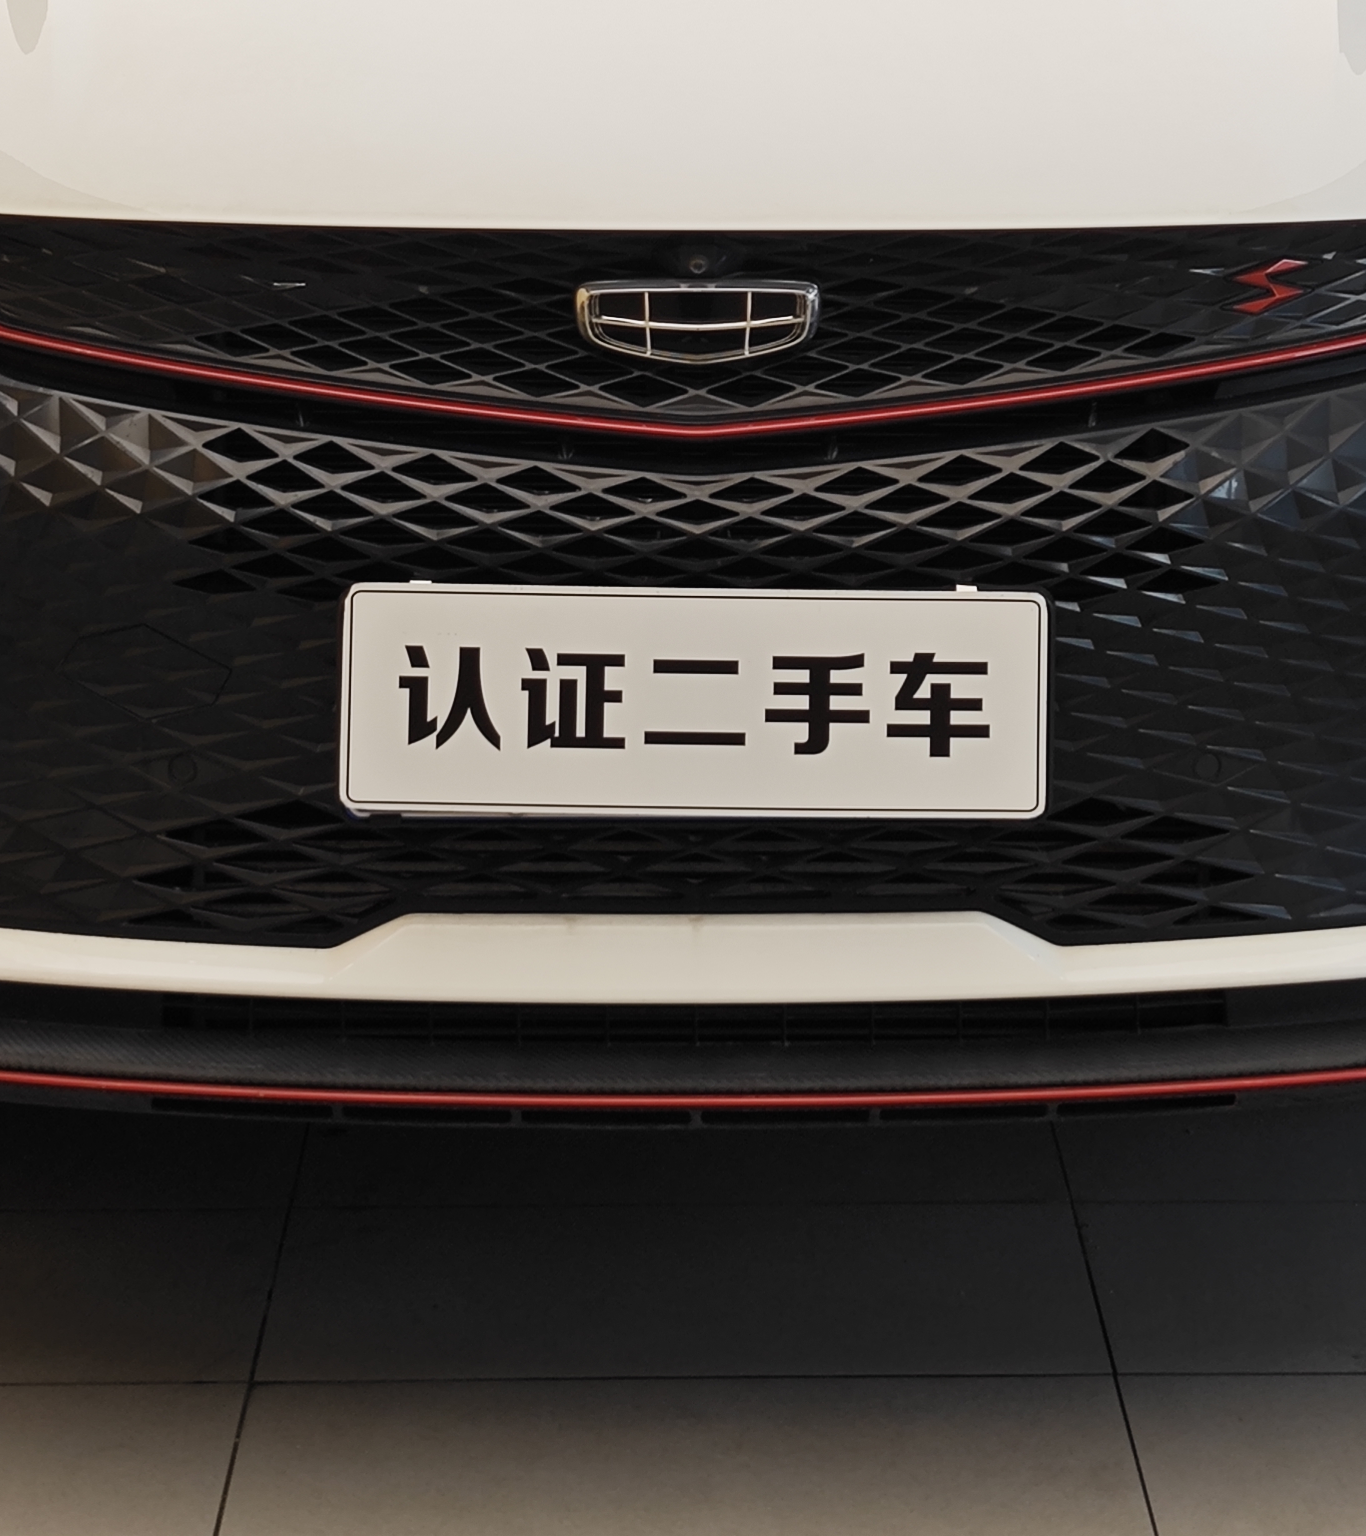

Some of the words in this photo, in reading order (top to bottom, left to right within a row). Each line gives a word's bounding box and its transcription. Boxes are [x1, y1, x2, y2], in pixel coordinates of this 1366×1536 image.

[399, 645, 991, 757] 认证二手车
